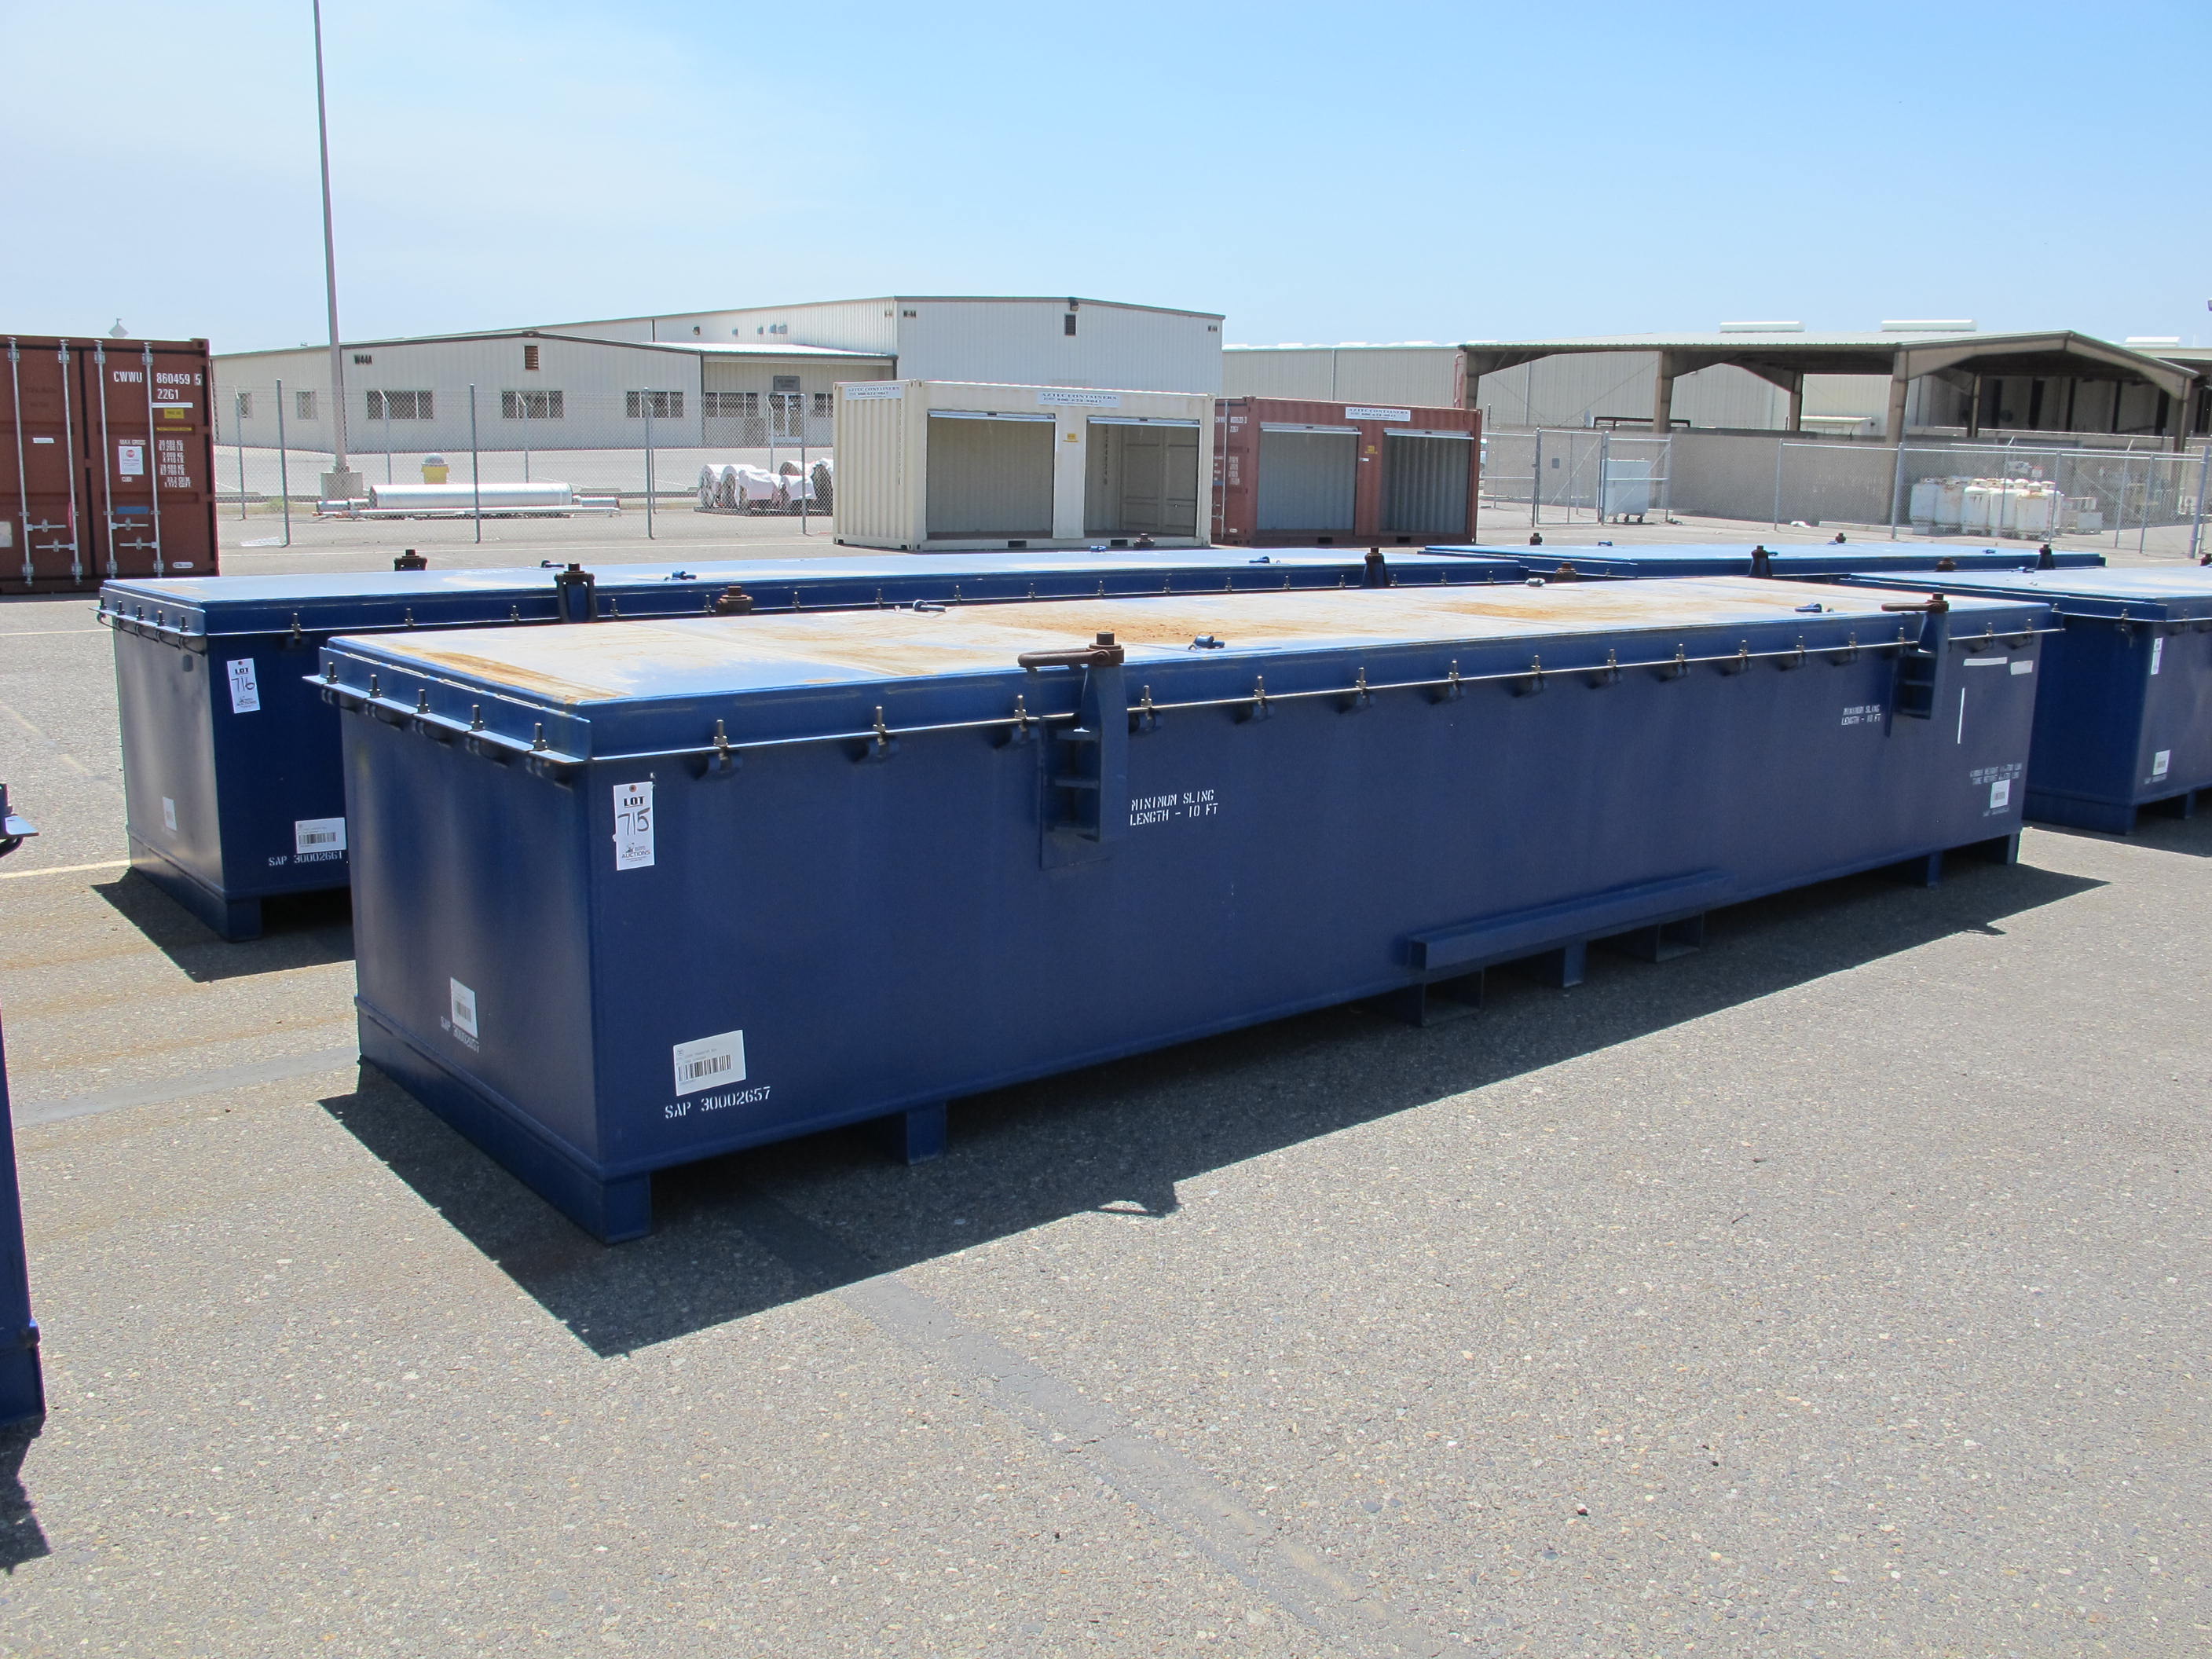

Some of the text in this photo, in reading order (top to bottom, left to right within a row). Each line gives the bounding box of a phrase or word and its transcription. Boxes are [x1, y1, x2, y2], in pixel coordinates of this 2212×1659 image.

[113, 371, 201, 385] CWWU 860459 5
[157, 389, 178, 400] 22G1
[231, 677, 255, 691] 716
[624, 796, 644, 807] LOT
[1131, 789, 1214, 811] MINIMUM SLING
[617, 807, 650, 836] 715
[1130, 809, 1169, 826] LENGTH
[1189, 805, 1200, 817] 10
[1206, 803, 1218, 815] FT
[269, 850, 342, 866] SAP 30002661
[665, 1086, 771, 1119] SAP 30002657
